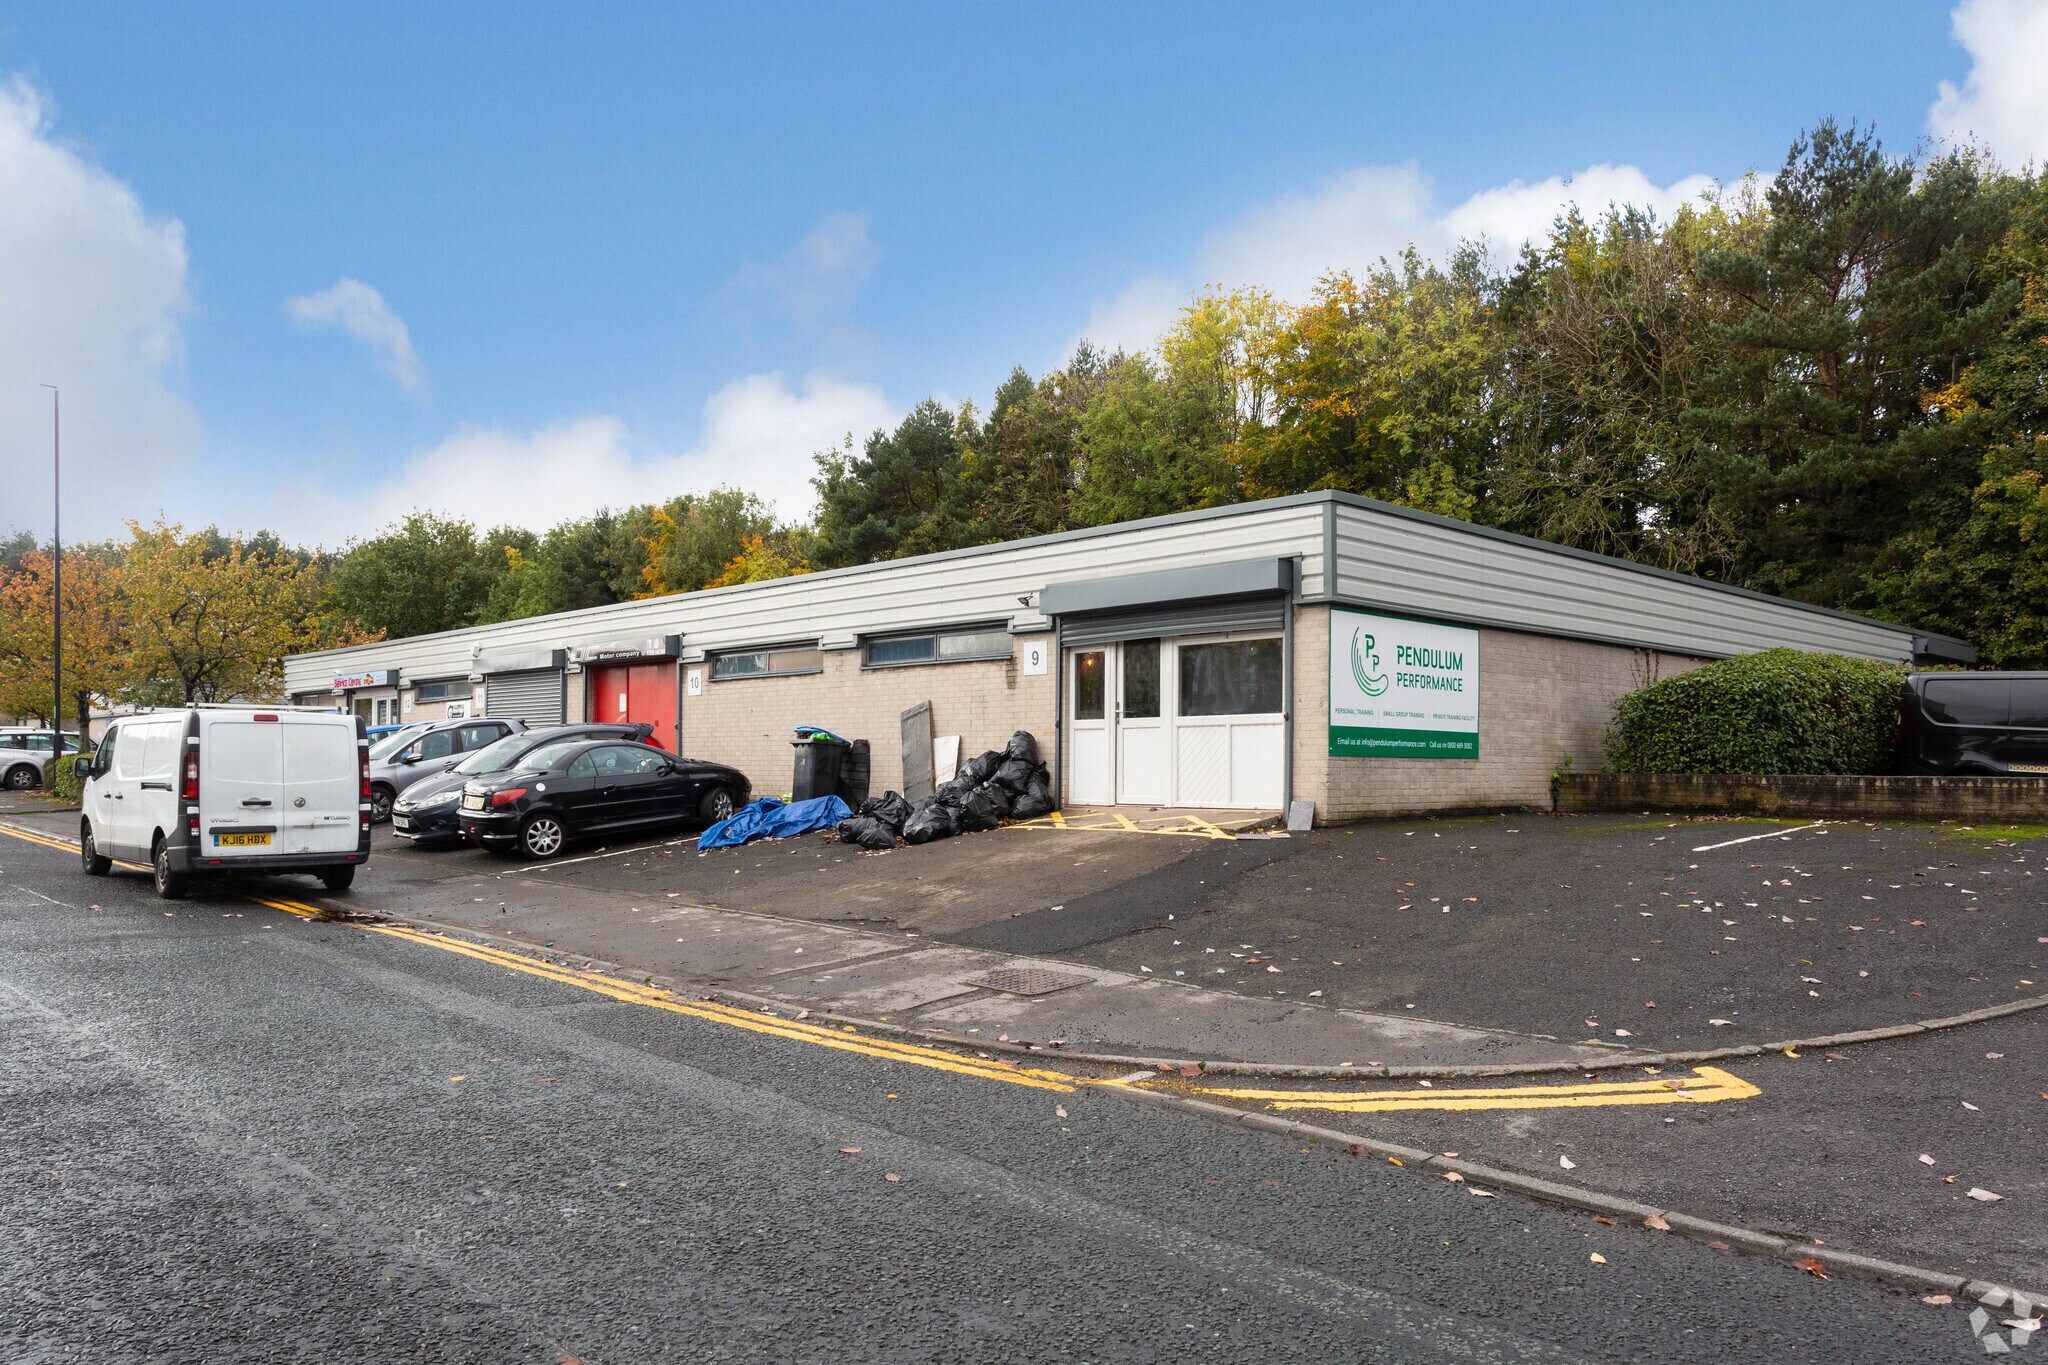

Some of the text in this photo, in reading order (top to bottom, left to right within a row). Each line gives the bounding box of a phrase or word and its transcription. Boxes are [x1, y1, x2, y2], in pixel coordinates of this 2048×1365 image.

[600, 652, 615, 660] Motor
[615, 650, 640, 659] company
[1031, 650, 1040, 666] 9
[1396, 645, 1463, 671] PENDULUM
[690, 676, 699, 689] 10
[1396, 672, 1463, 692] PERFORMANCE
[1335, 707, 1355, 715] PERSONAL
[1337, 737, 1350, 745] Email
[222, 835, 267, 845] KJ16 HBX
